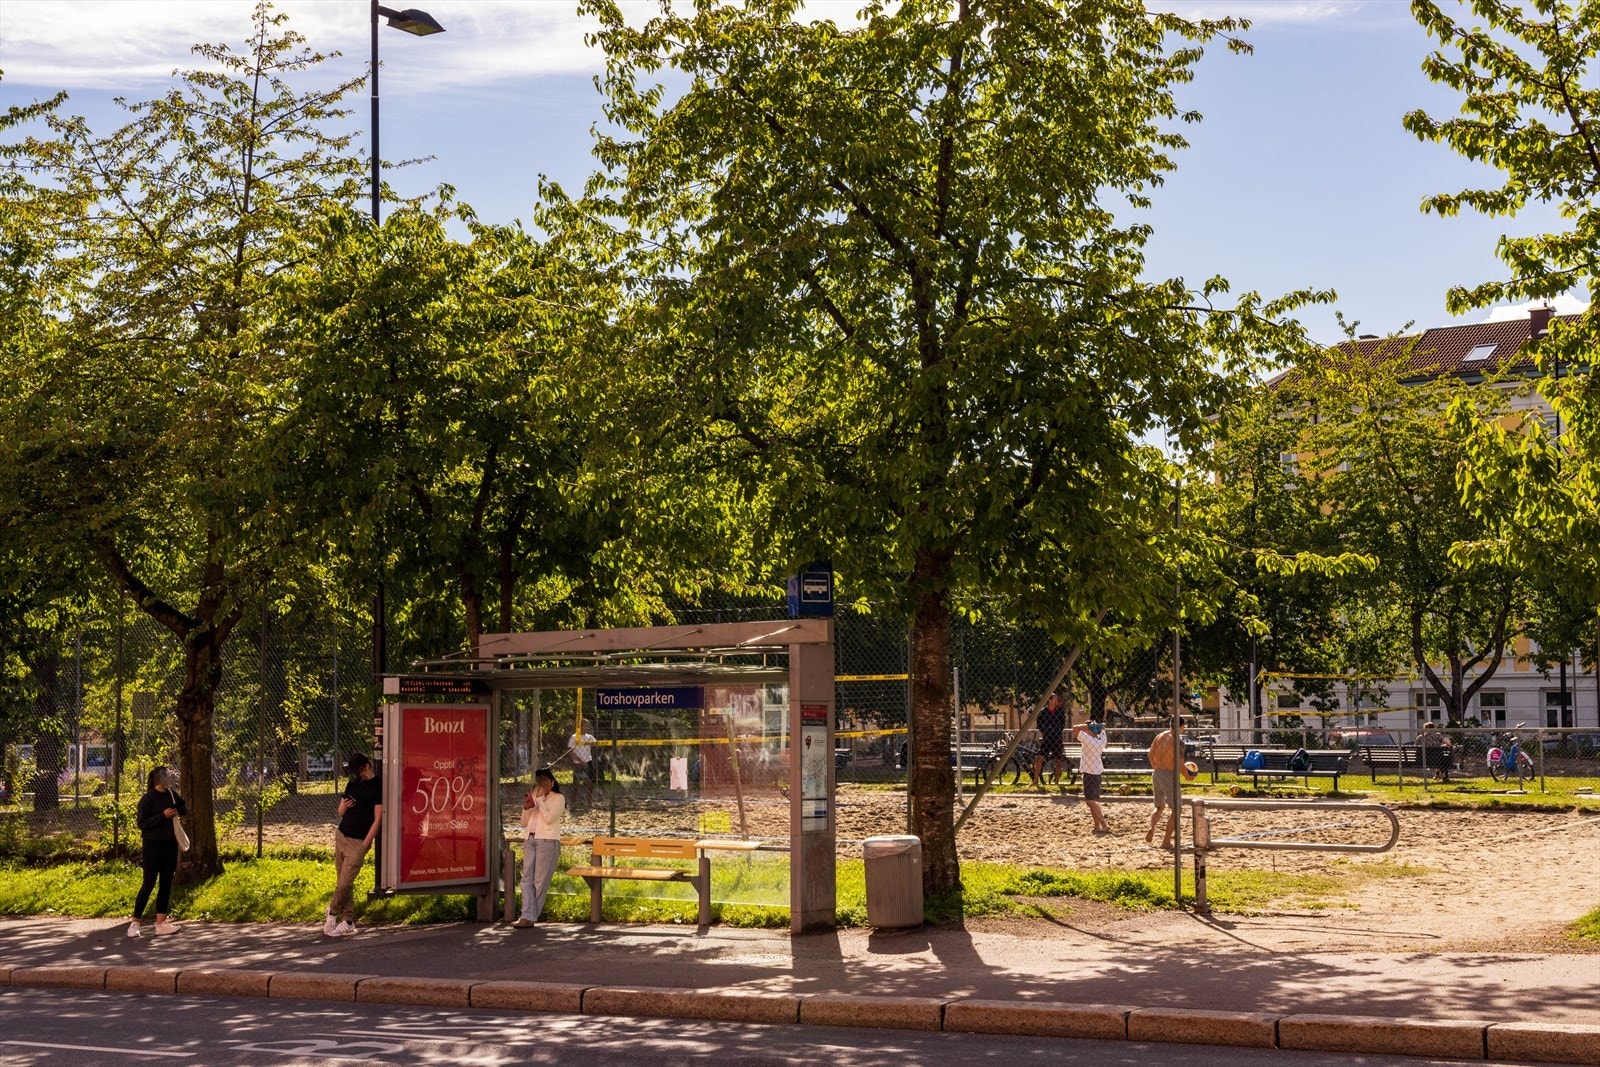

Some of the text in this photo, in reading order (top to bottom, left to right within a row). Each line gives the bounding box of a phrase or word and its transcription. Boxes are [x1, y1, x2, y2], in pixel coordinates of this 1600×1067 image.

[598, 691, 675, 708] Torshovparken
[424, 716, 465, 733] Boozt
[433, 760, 455, 771] Opptil
[412, 776, 473, 814] 50%
[450, 819, 469, 829] Sale
